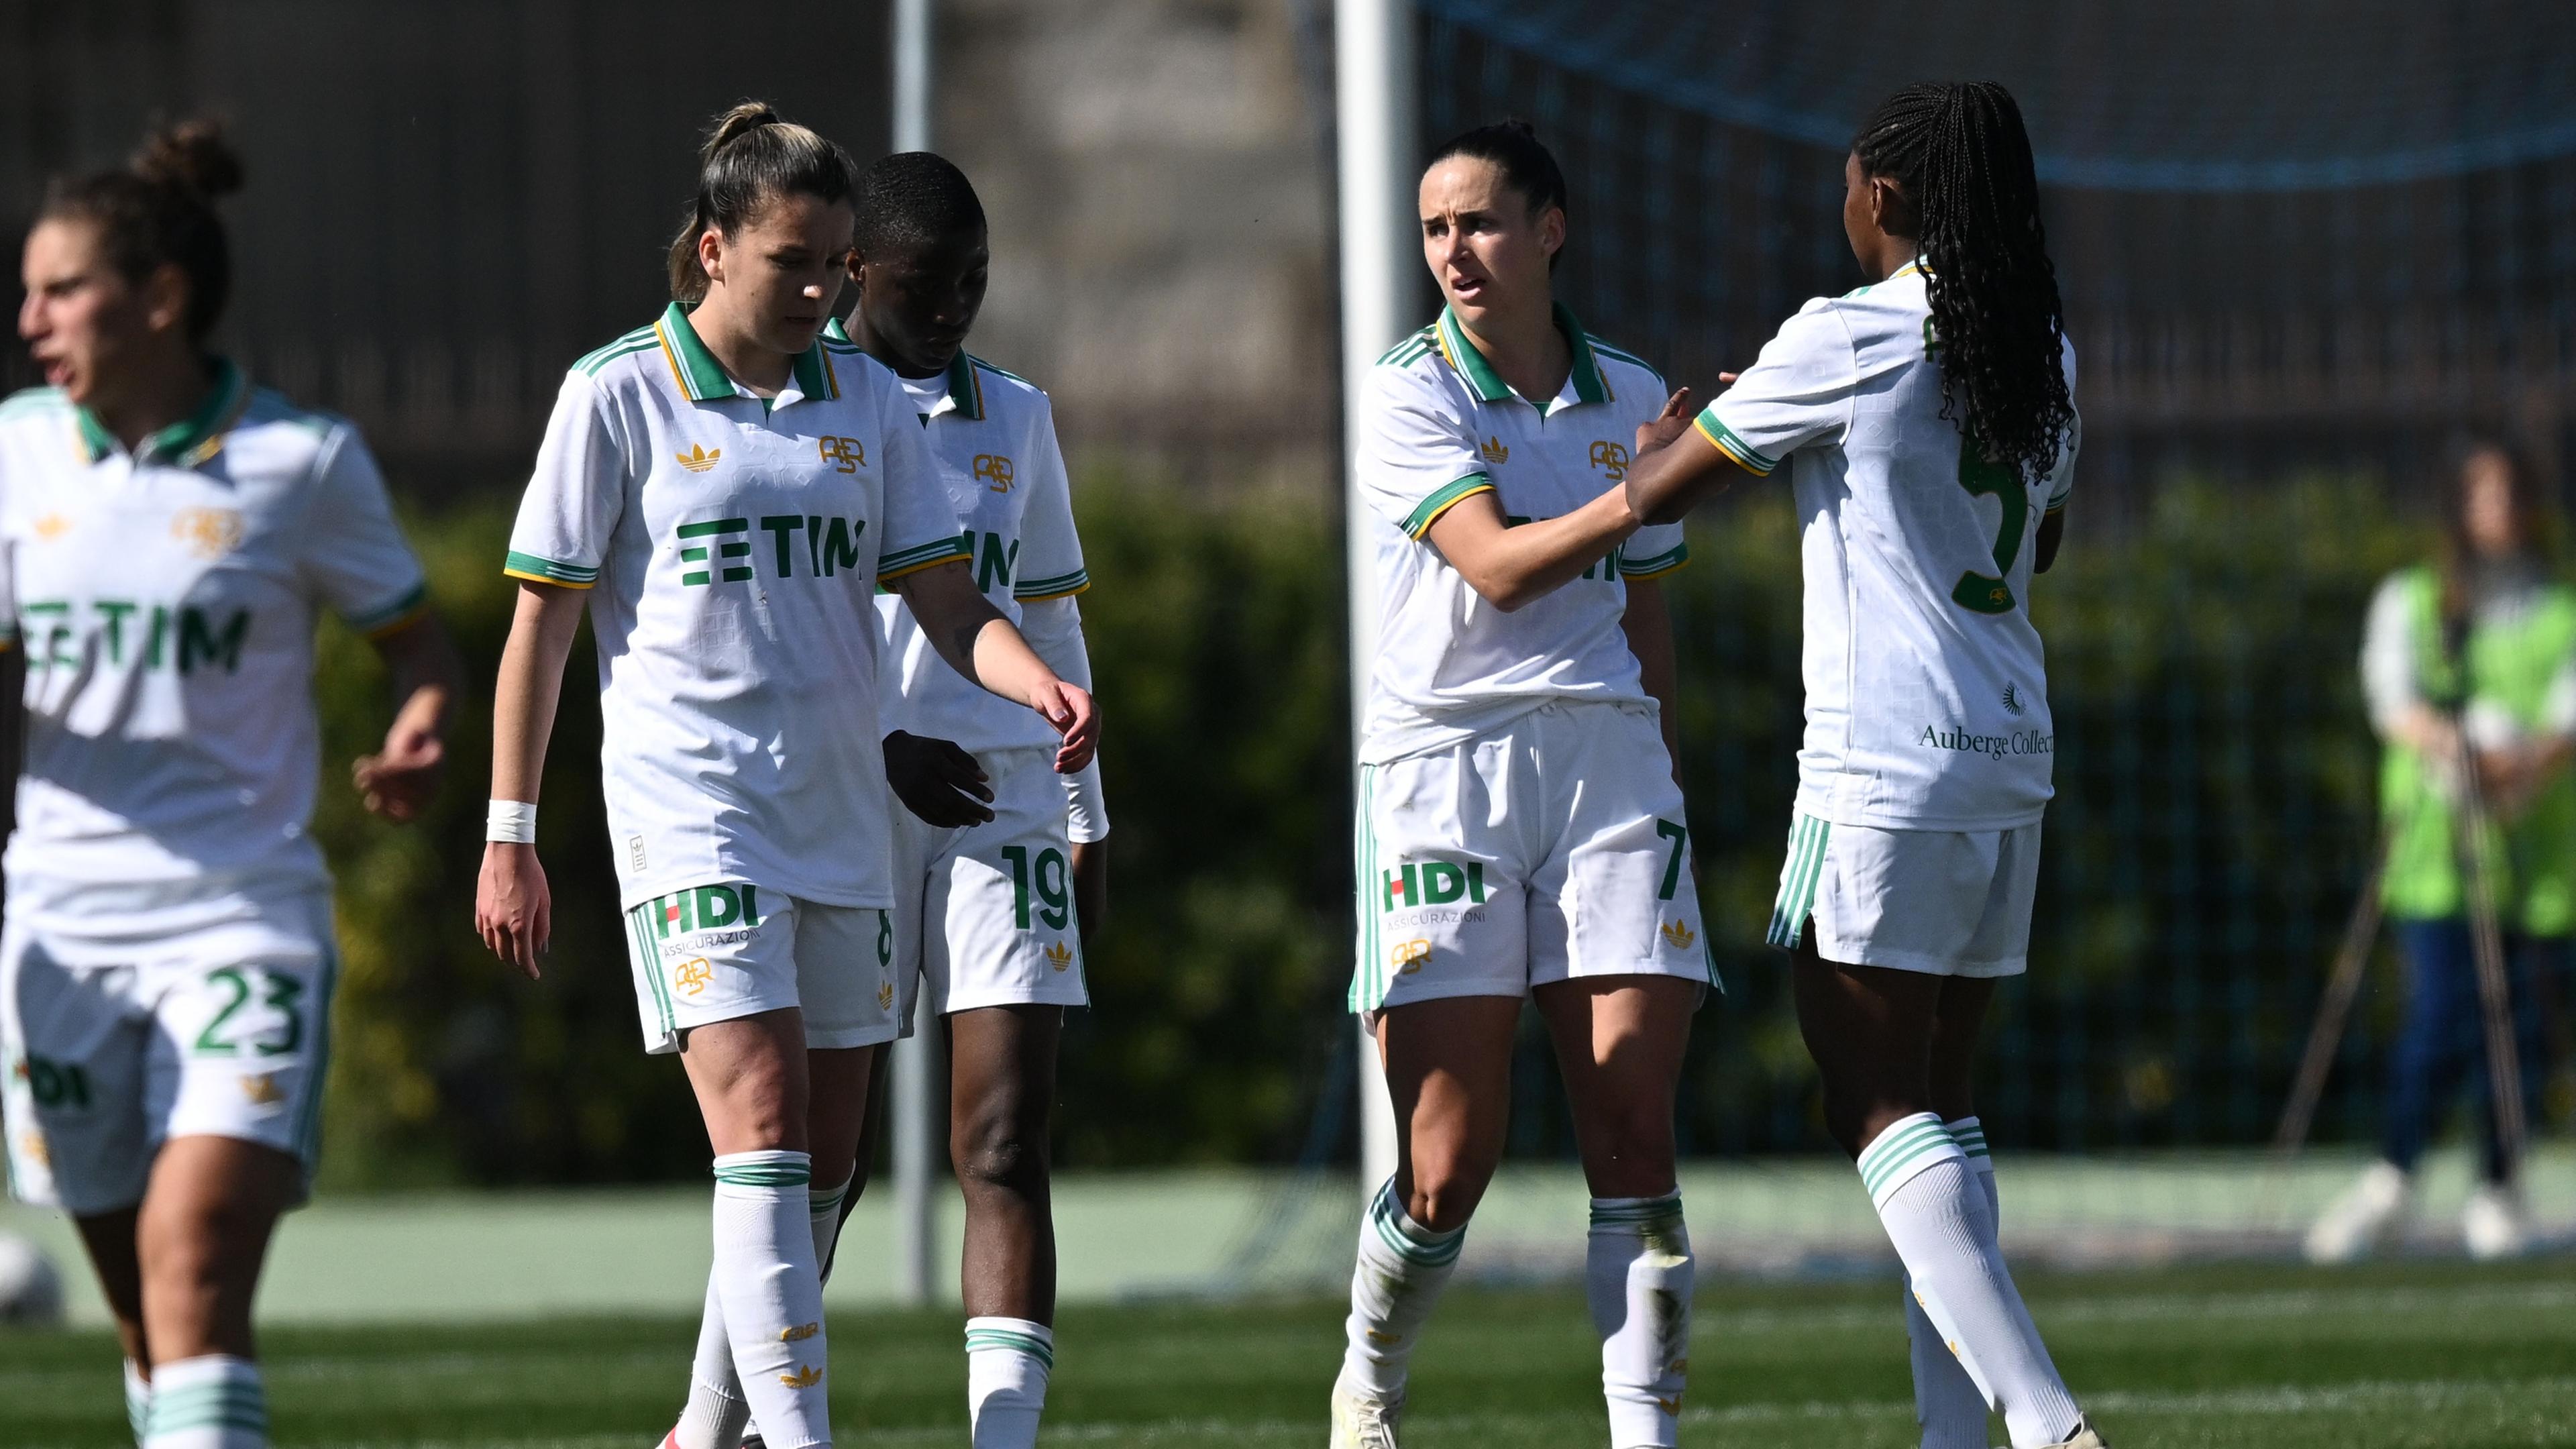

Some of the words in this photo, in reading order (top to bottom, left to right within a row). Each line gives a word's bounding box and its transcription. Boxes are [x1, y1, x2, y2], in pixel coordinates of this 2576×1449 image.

[93, 600, 251, 676] TIM
[1918, 724, 2008, 761] Auberge
[1001, 846, 1068, 930] 19
[1383, 862, 1486, 914] HDI
[1656, 818, 1686, 900] 7
[654, 884, 759, 940] HDI
[1387, 912, 1485, 932] ASSICURAZIONI
[195, 967, 301, 1055] 23
